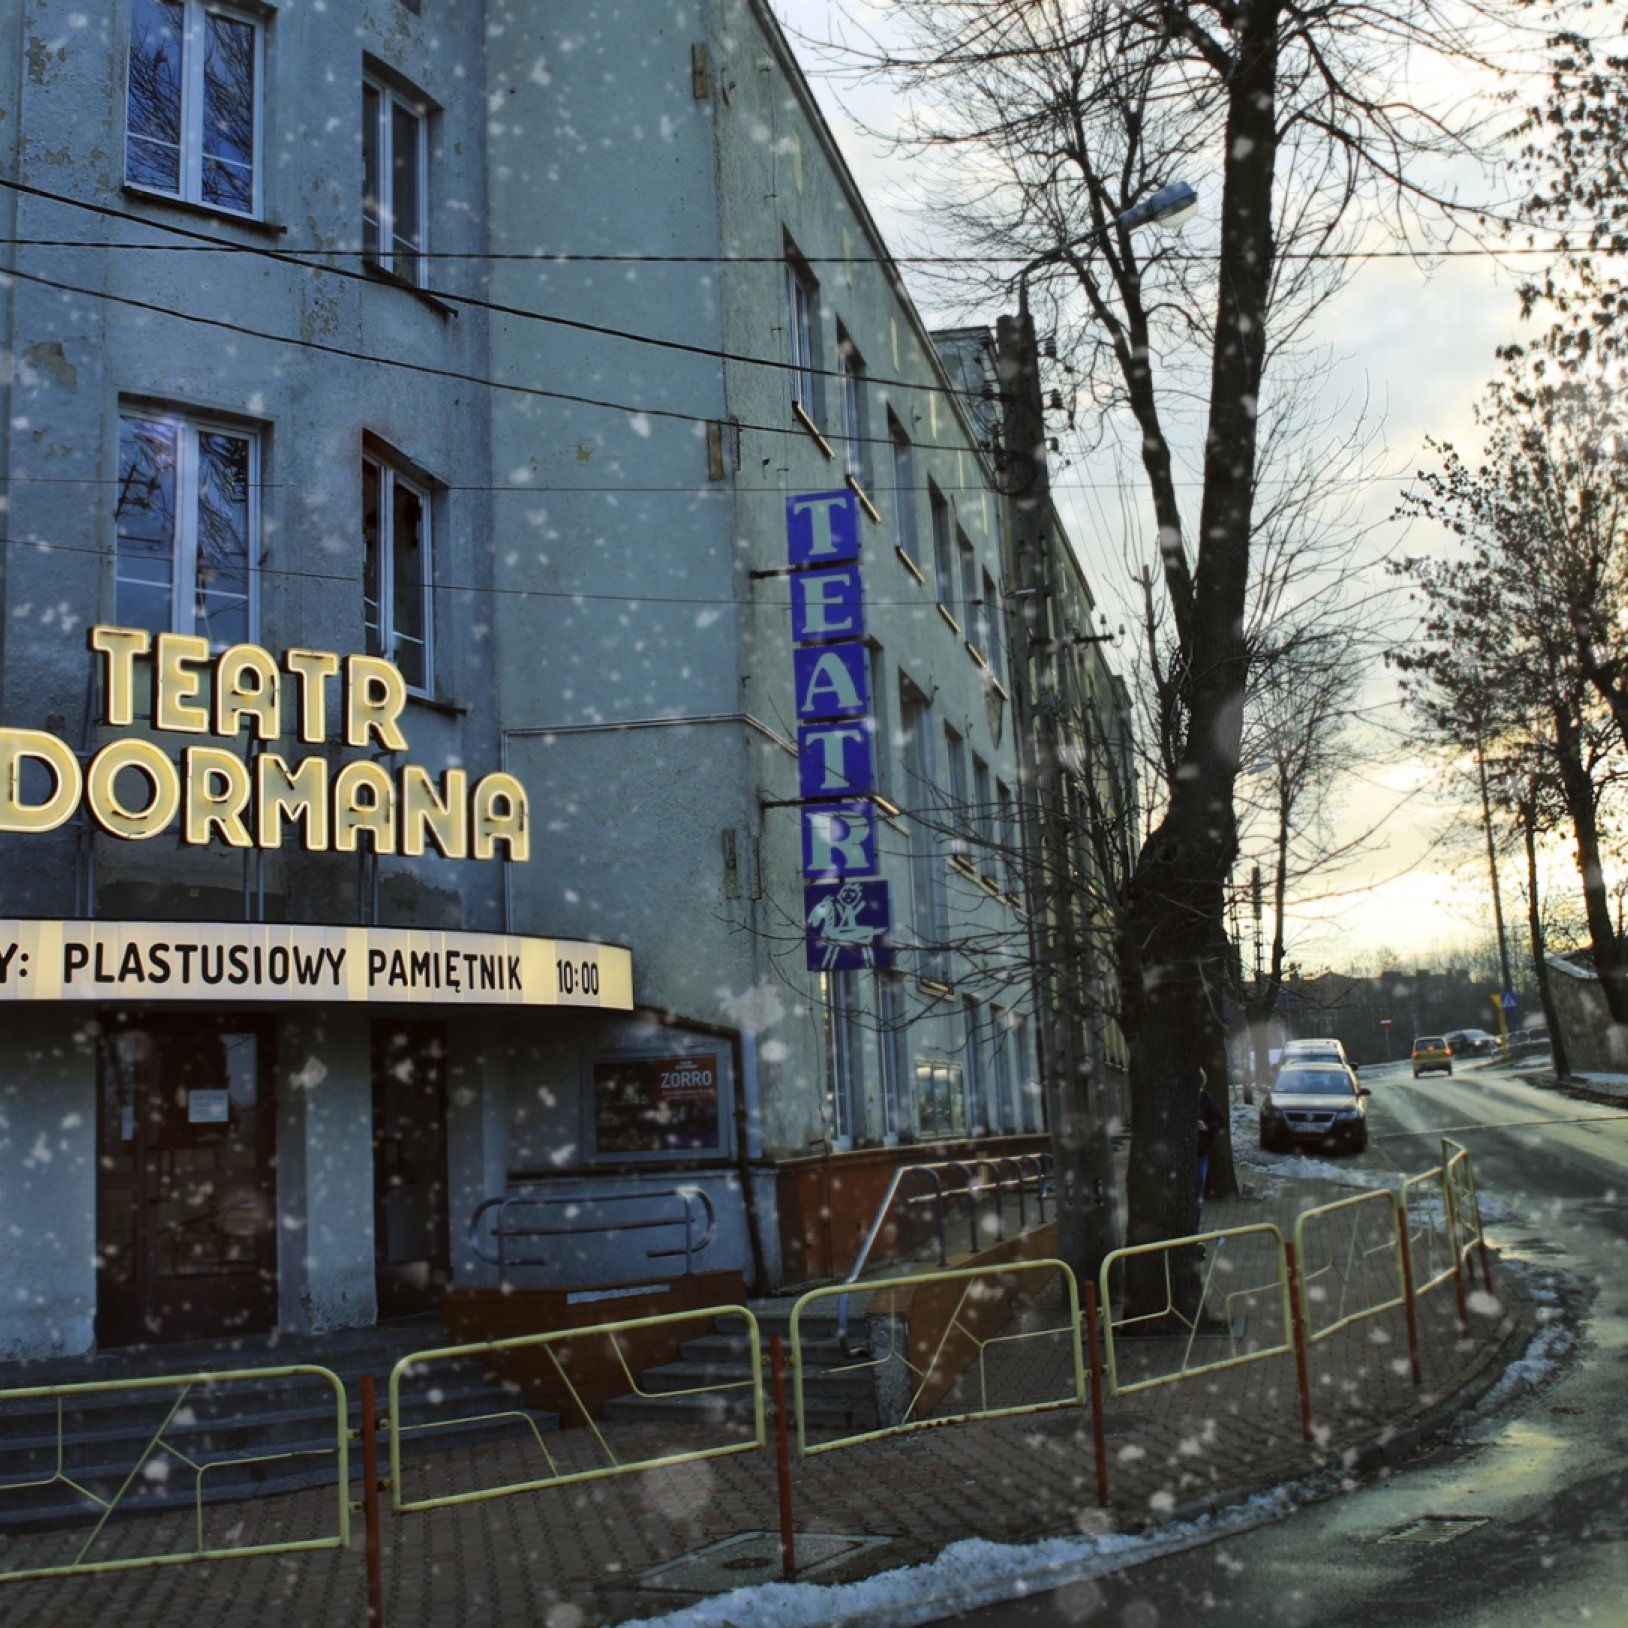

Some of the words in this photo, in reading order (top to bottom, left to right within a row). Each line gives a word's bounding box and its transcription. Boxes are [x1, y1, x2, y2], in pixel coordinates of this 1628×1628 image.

[91, 625, 409, 752] TEATR
[793, 496, 871, 872] TEATR
[0, 726, 531, 863] DORMANA
[64, 942, 347, 985] PLASTUSIOWY
[368, 949, 523, 994] PAMIĘTNIK
[556, 958, 600, 996] 10:00
[660, 1070, 712, 1088] ZORRO
